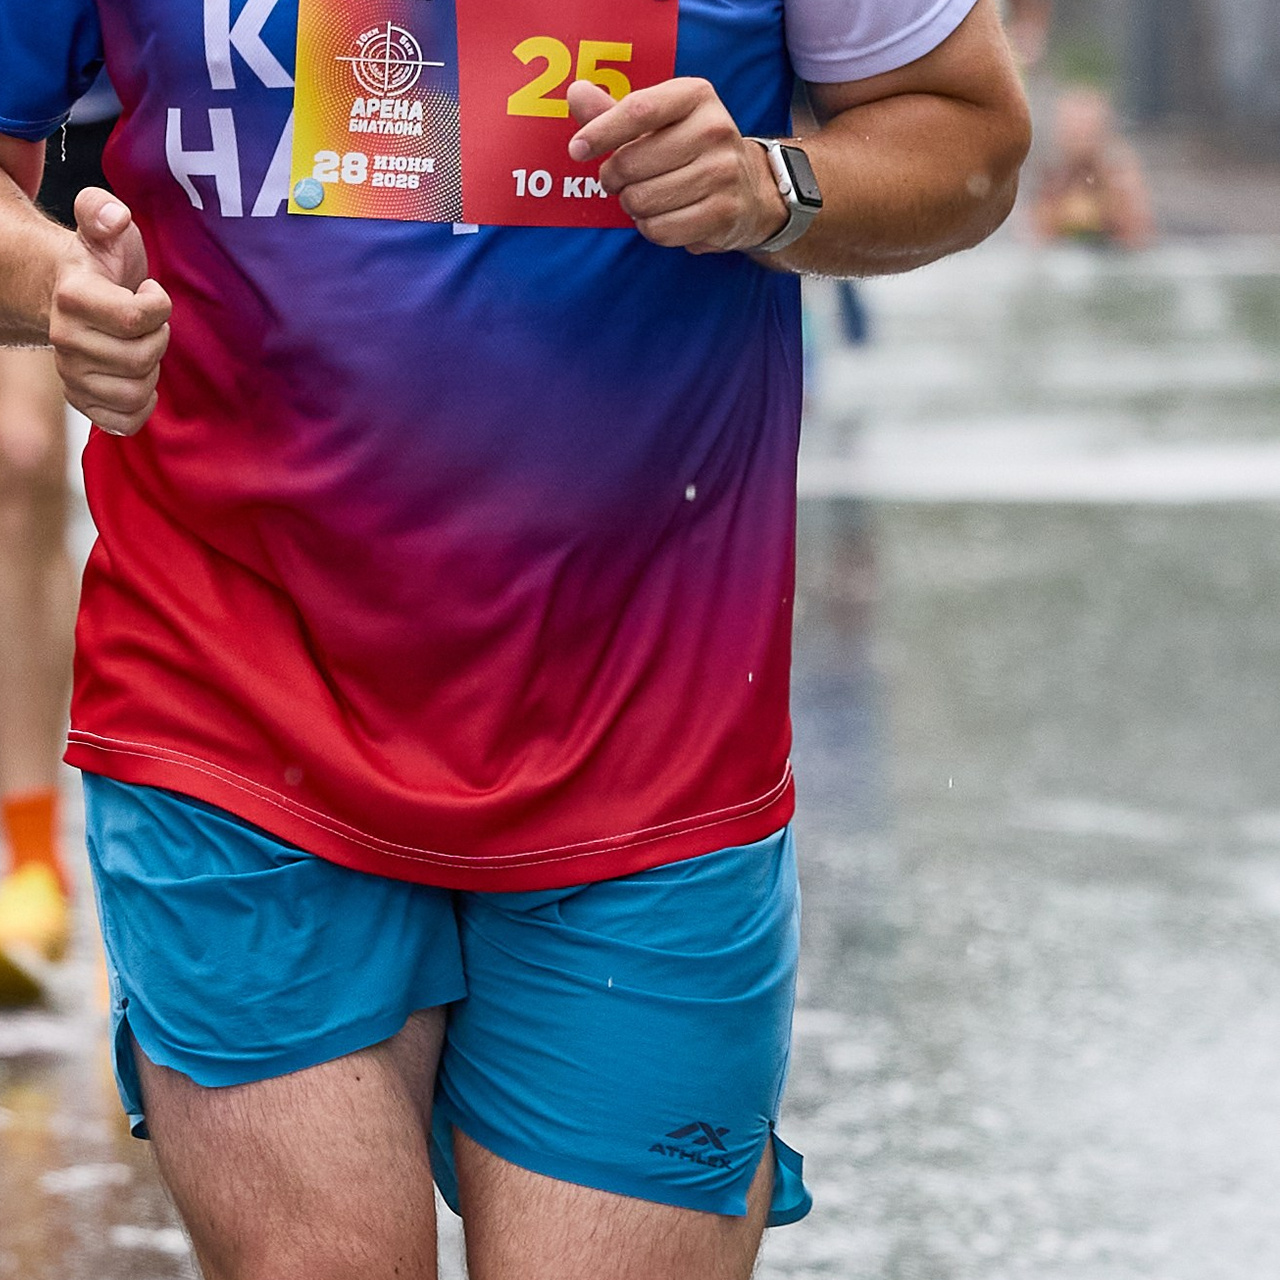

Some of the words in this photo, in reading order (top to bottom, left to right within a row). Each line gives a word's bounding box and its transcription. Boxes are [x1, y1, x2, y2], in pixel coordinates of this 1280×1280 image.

[506, 35, 633, 119] 25
[350, 97, 424, 121] АРЕНА
[348, 119, 424, 136] БИАТЛОНА
[312, 150, 369, 185] 28
[371, 172, 421, 190] 2026
[511, 168, 553, 198] 10
